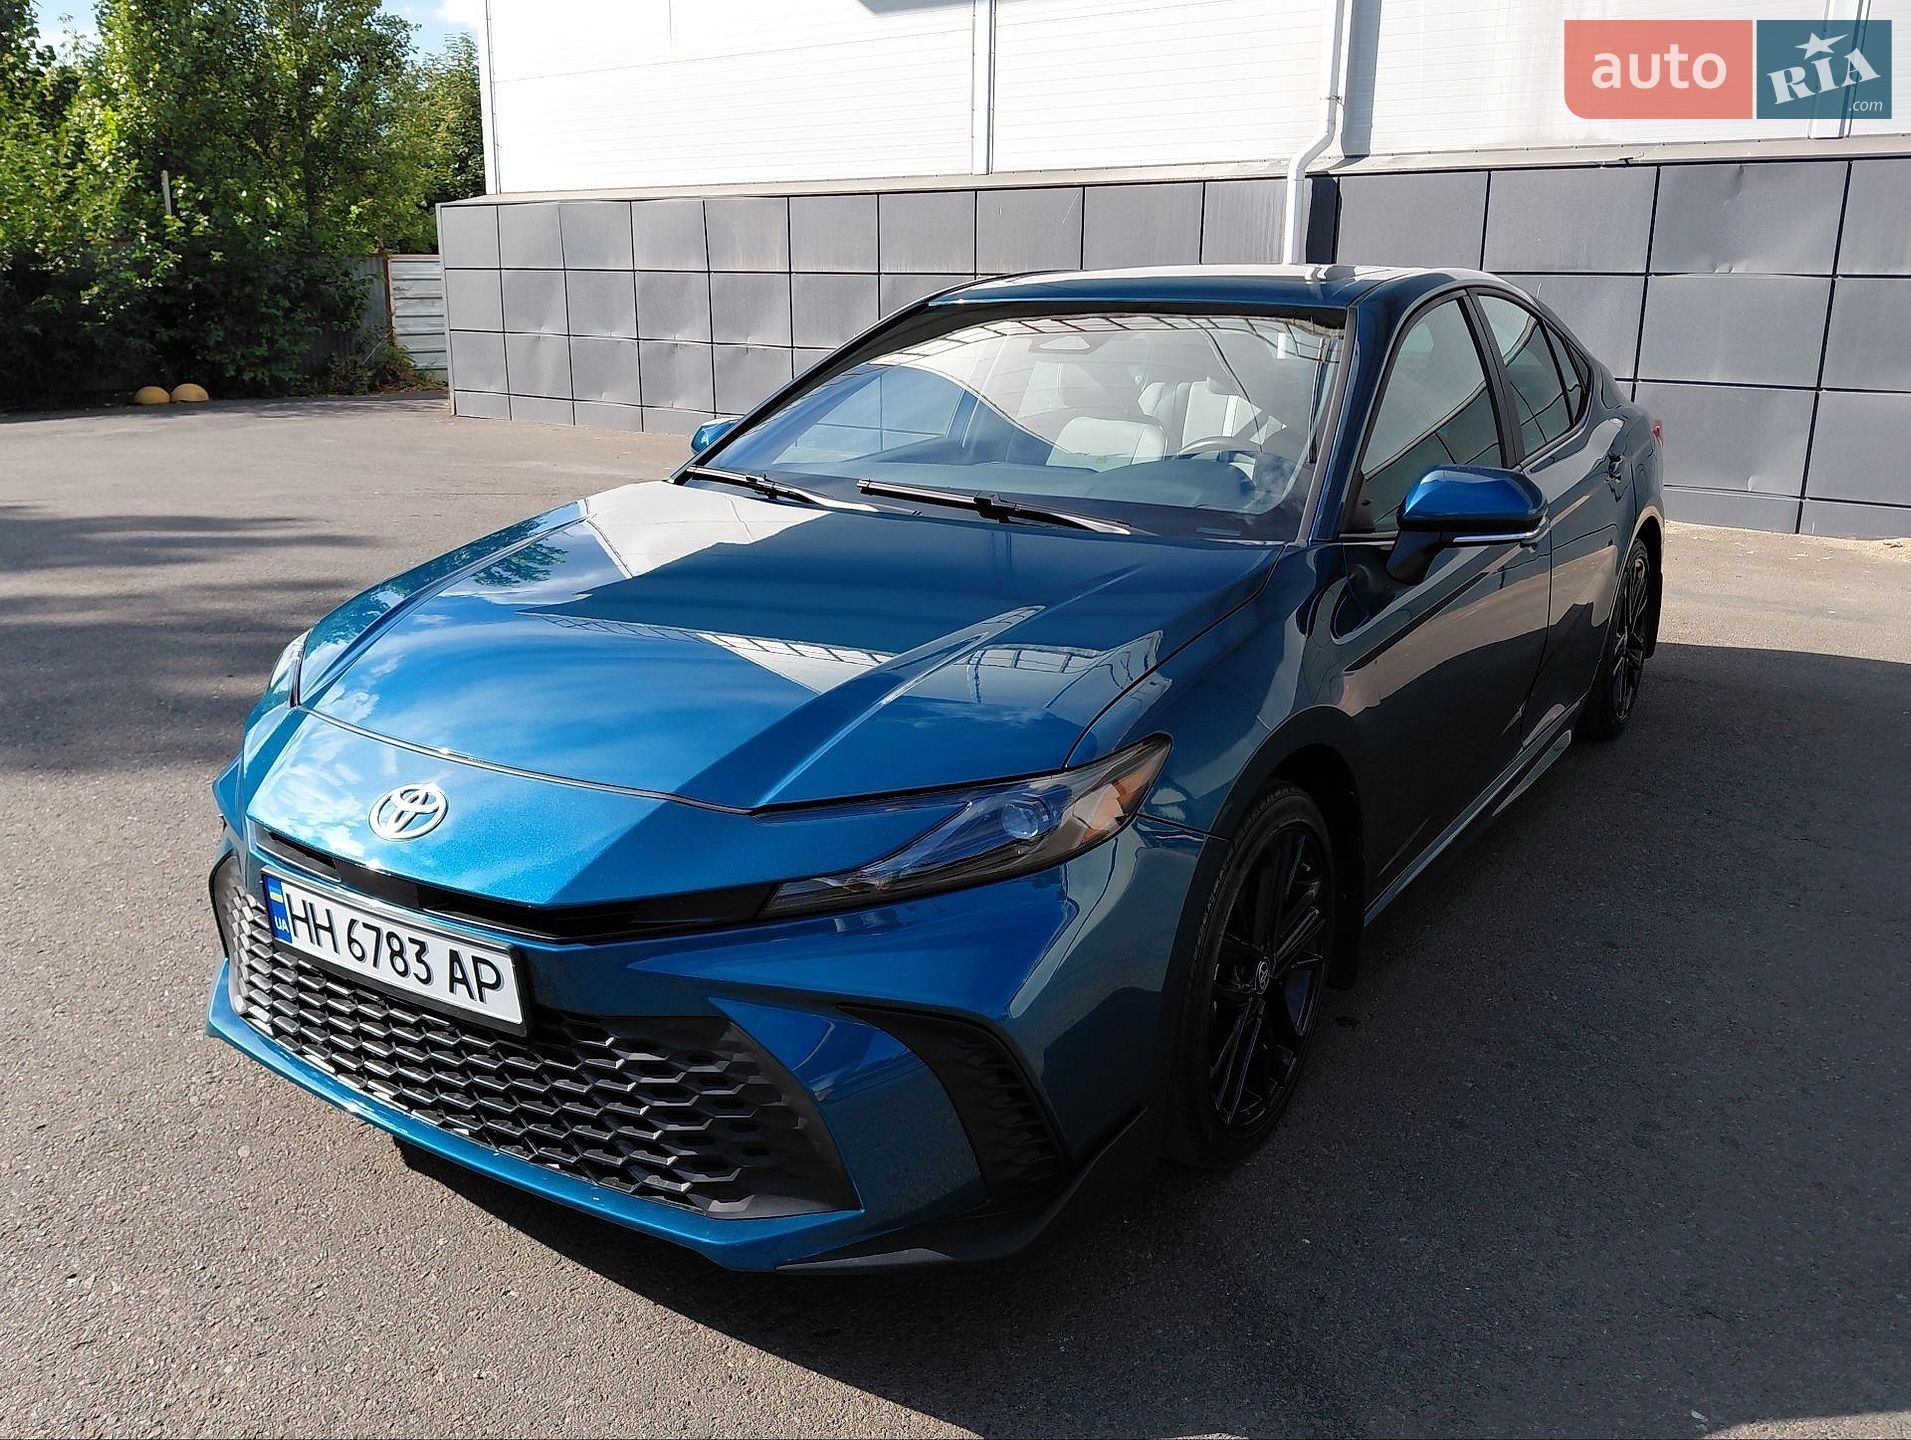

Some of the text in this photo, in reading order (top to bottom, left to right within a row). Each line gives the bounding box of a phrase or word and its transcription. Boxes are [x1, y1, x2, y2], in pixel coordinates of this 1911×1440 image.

[275, 917, 289, 934] UA
[286, 893, 501, 1003] HH 6783 AP
